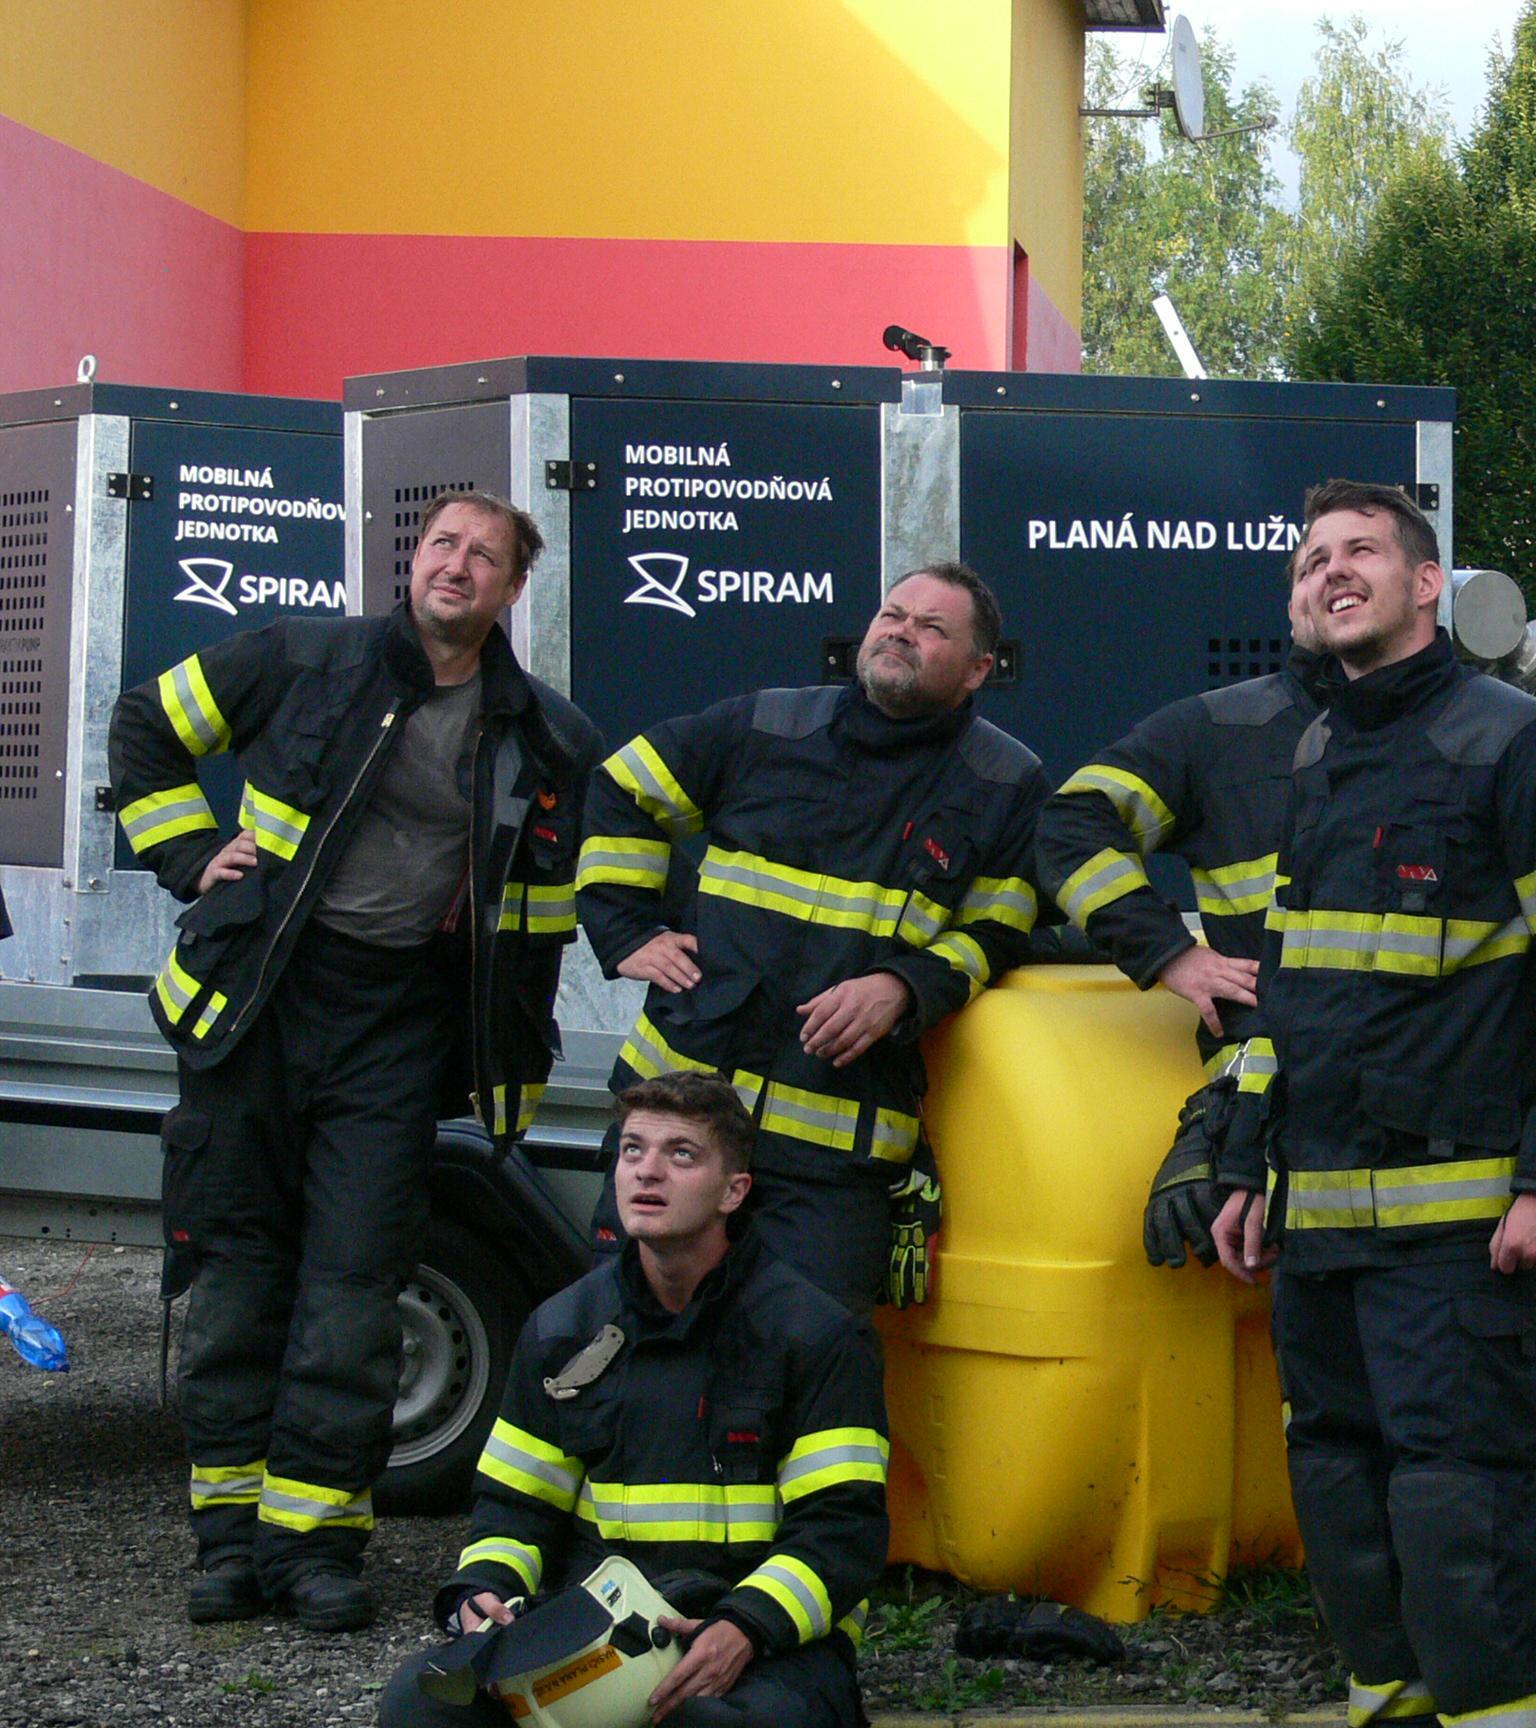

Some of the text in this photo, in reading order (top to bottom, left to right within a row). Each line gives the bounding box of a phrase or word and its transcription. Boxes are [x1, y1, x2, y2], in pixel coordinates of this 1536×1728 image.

[625, 442, 731, 467] MOBILNÁ
[179, 464, 274, 489] MOBILNÁ
[625, 475, 833, 501] PROTIPOVODŇOVÁ
[174, 519, 279, 544] JEDNOTKA
[622, 509, 739, 533] JEDNOTKA
[1028, 512, 1139, 549] PLANÁ
[1147, 520, 1217, 550] NAD
[697, 569, 834, 604] SPIRAM
